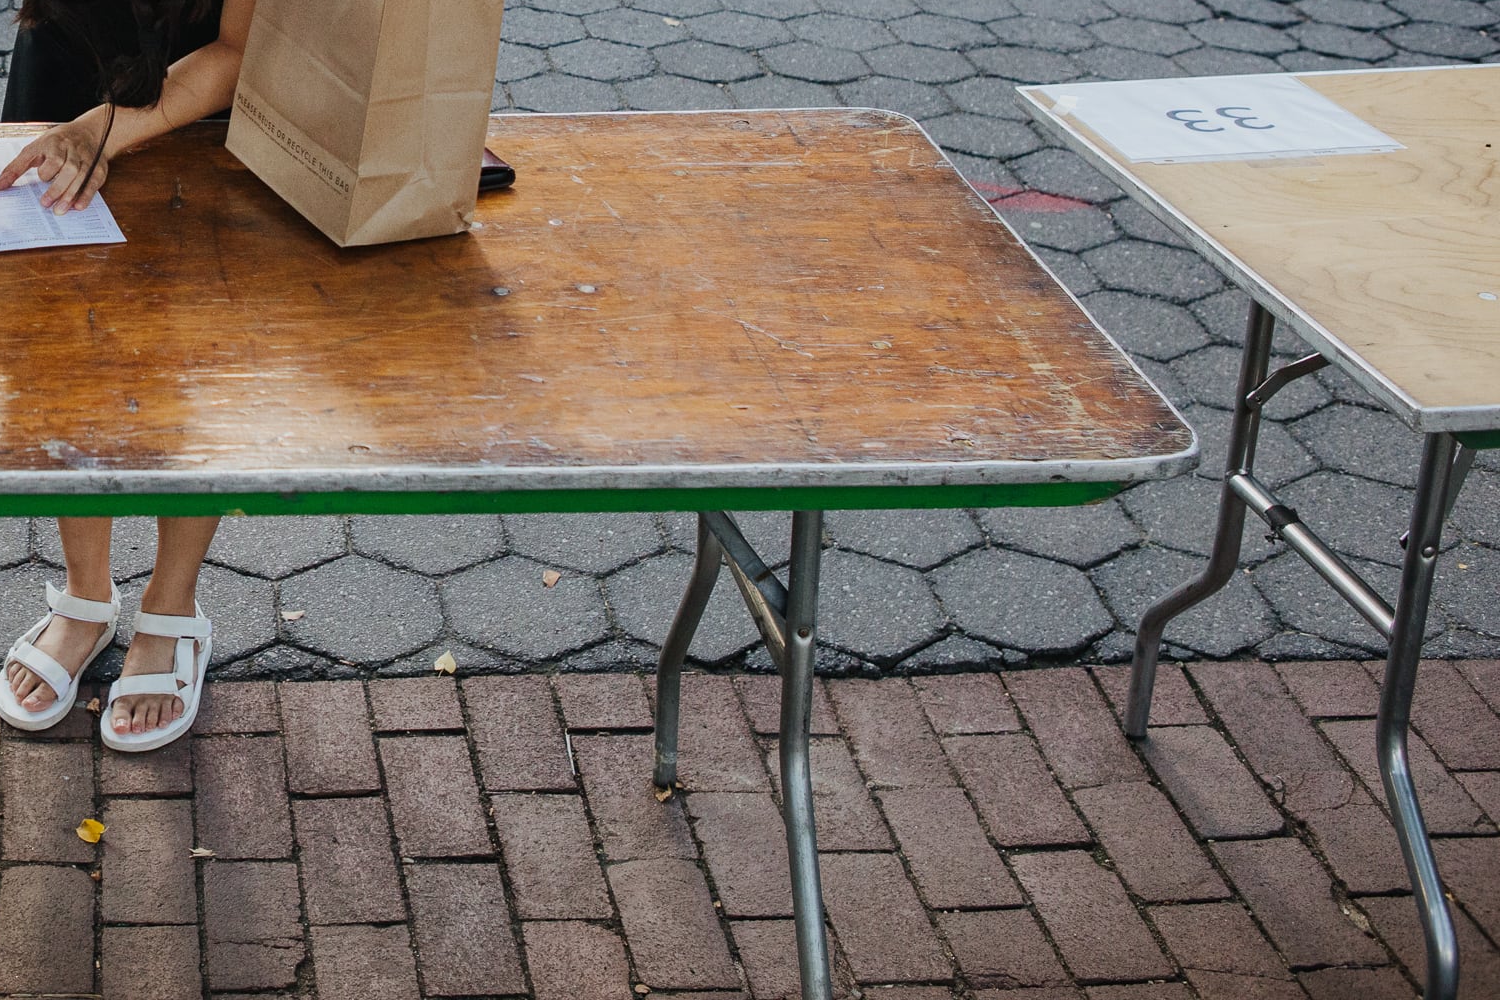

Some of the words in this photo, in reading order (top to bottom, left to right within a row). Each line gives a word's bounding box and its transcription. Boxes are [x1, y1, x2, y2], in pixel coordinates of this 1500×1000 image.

[237, 93, 258, 117] PLEASE
[258, 112, 276, 134] REUSE
[276, 129, 286, 143] OR
[286, 138, 317, 167] RECYCLE
[318, 162, 334, 181] THIS
[334, 176, 350, 193] BAG
[1165, 106, 1276, 133] 33
